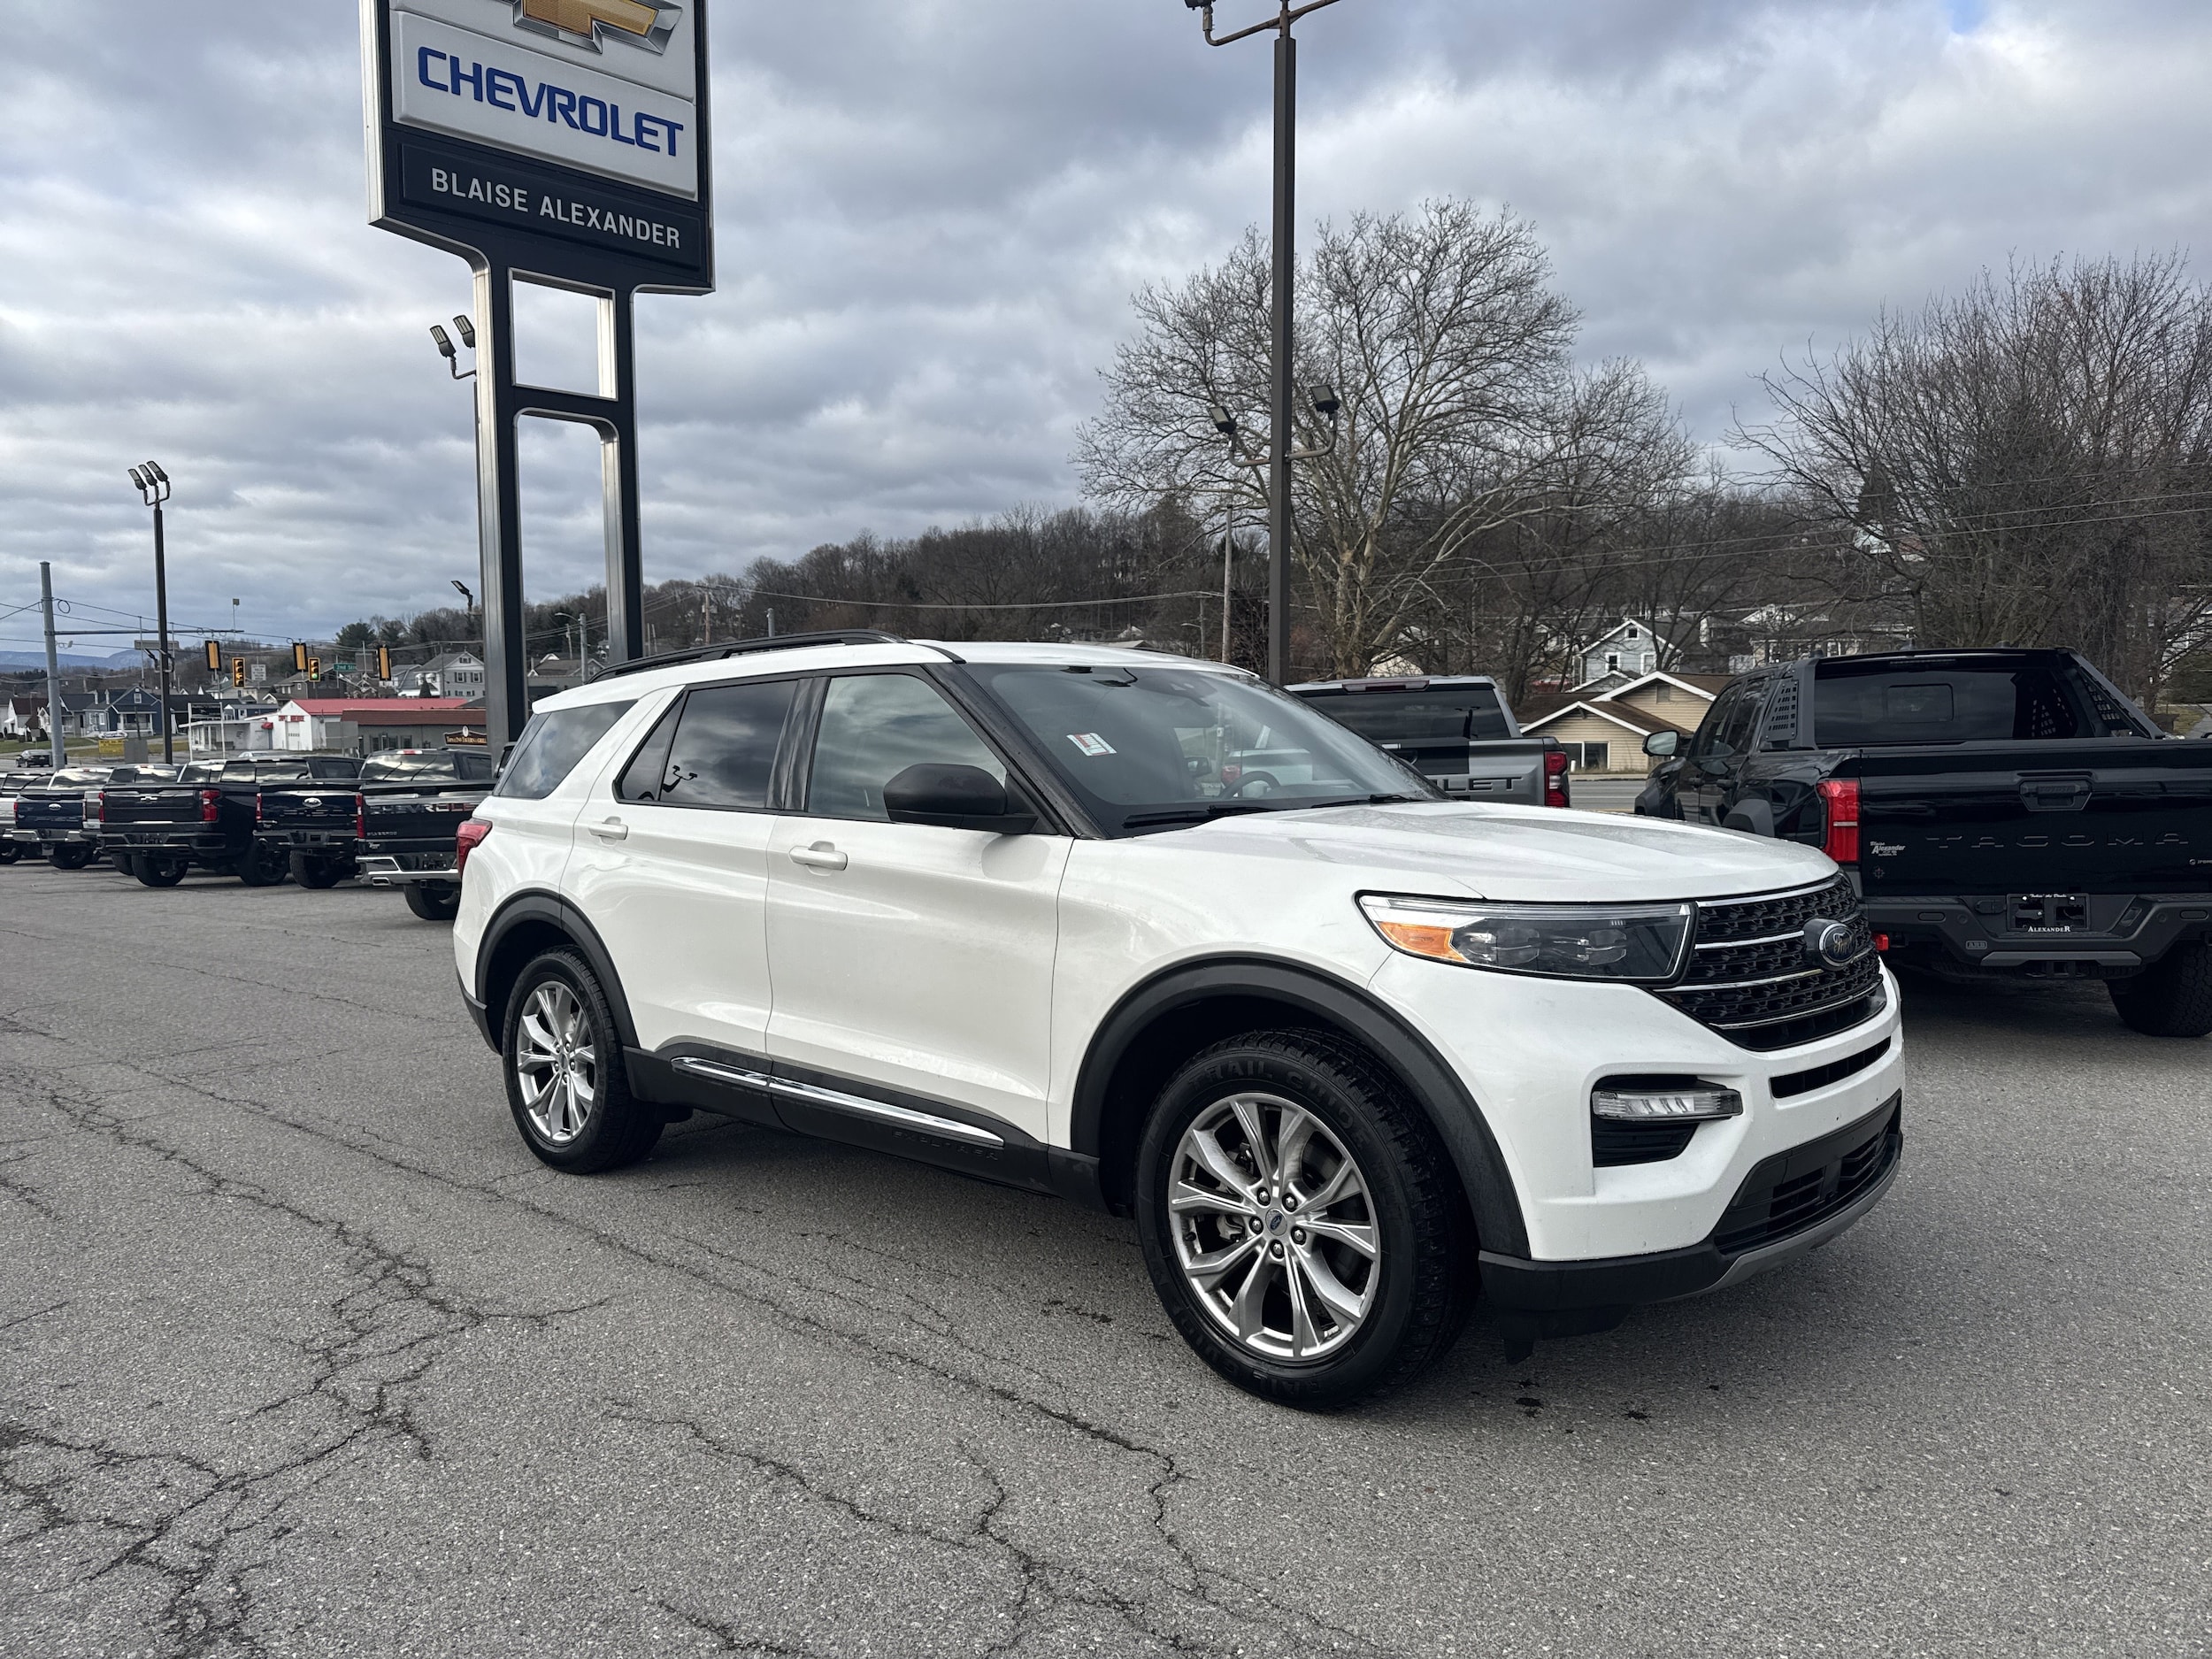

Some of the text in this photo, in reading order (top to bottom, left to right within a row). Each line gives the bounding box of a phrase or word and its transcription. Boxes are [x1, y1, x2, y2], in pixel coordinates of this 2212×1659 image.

[418, 46, 684, 157] CHEVROLET
[431, 167, 680, 250] BLAISE ALEXANDER
[370, 803, 478, 815] CHEVROLE
[1924, 832, 2189, 849] TACOMA
[1870, 845, 1906, 855] Alexander
